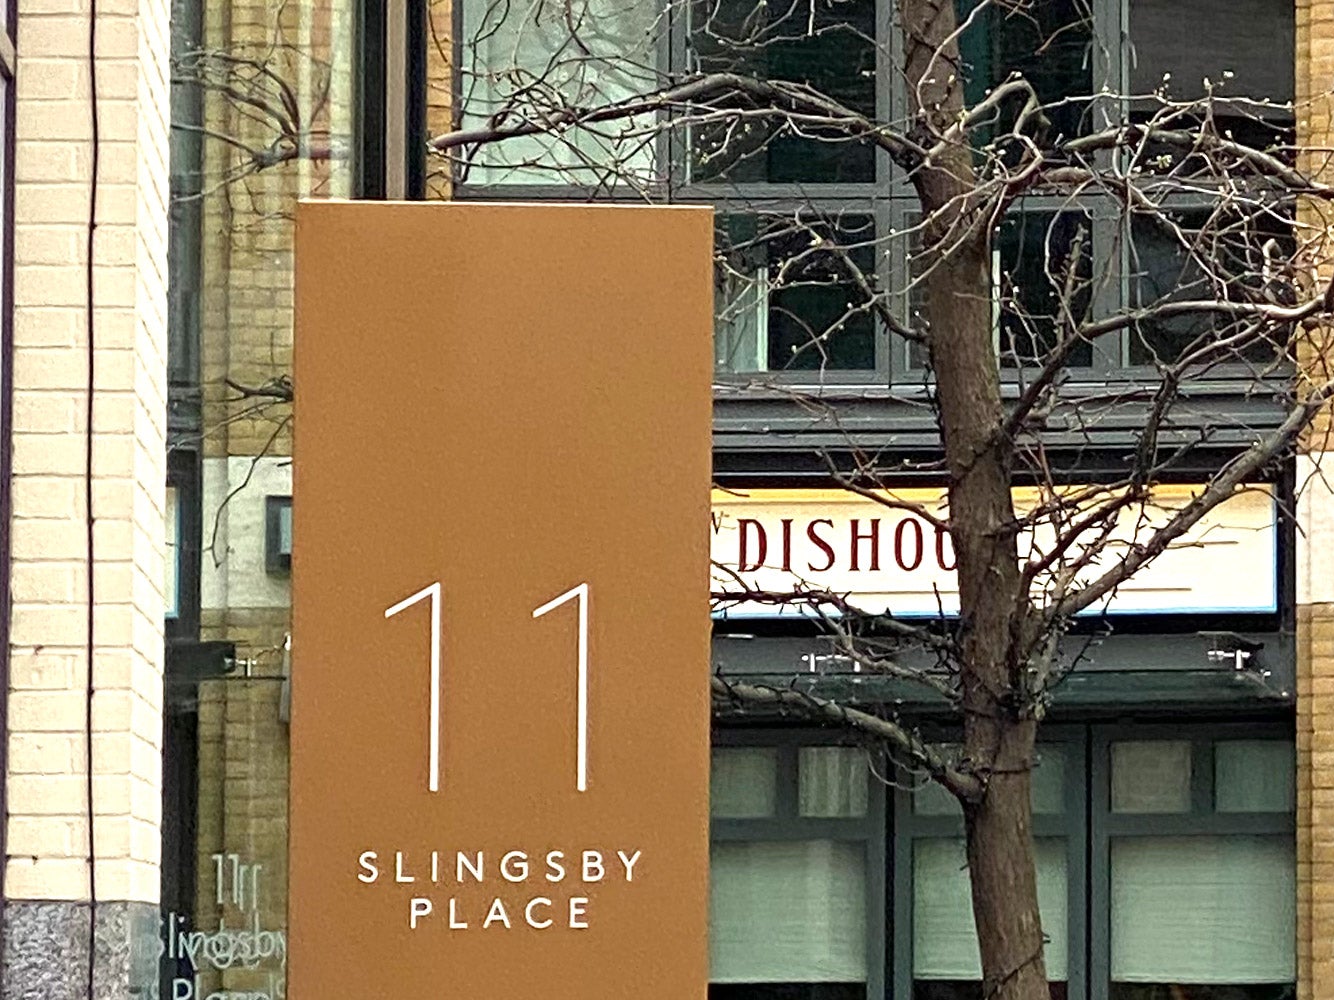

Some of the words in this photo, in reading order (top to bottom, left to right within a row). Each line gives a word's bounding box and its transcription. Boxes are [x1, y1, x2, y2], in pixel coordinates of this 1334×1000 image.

[737, 517, 959, 573] DISHOO
[385, 582, 588, 792] 11
[357, 850, 642, 884] SLINGSBY
[410, 897, 590, 930] PLACE
